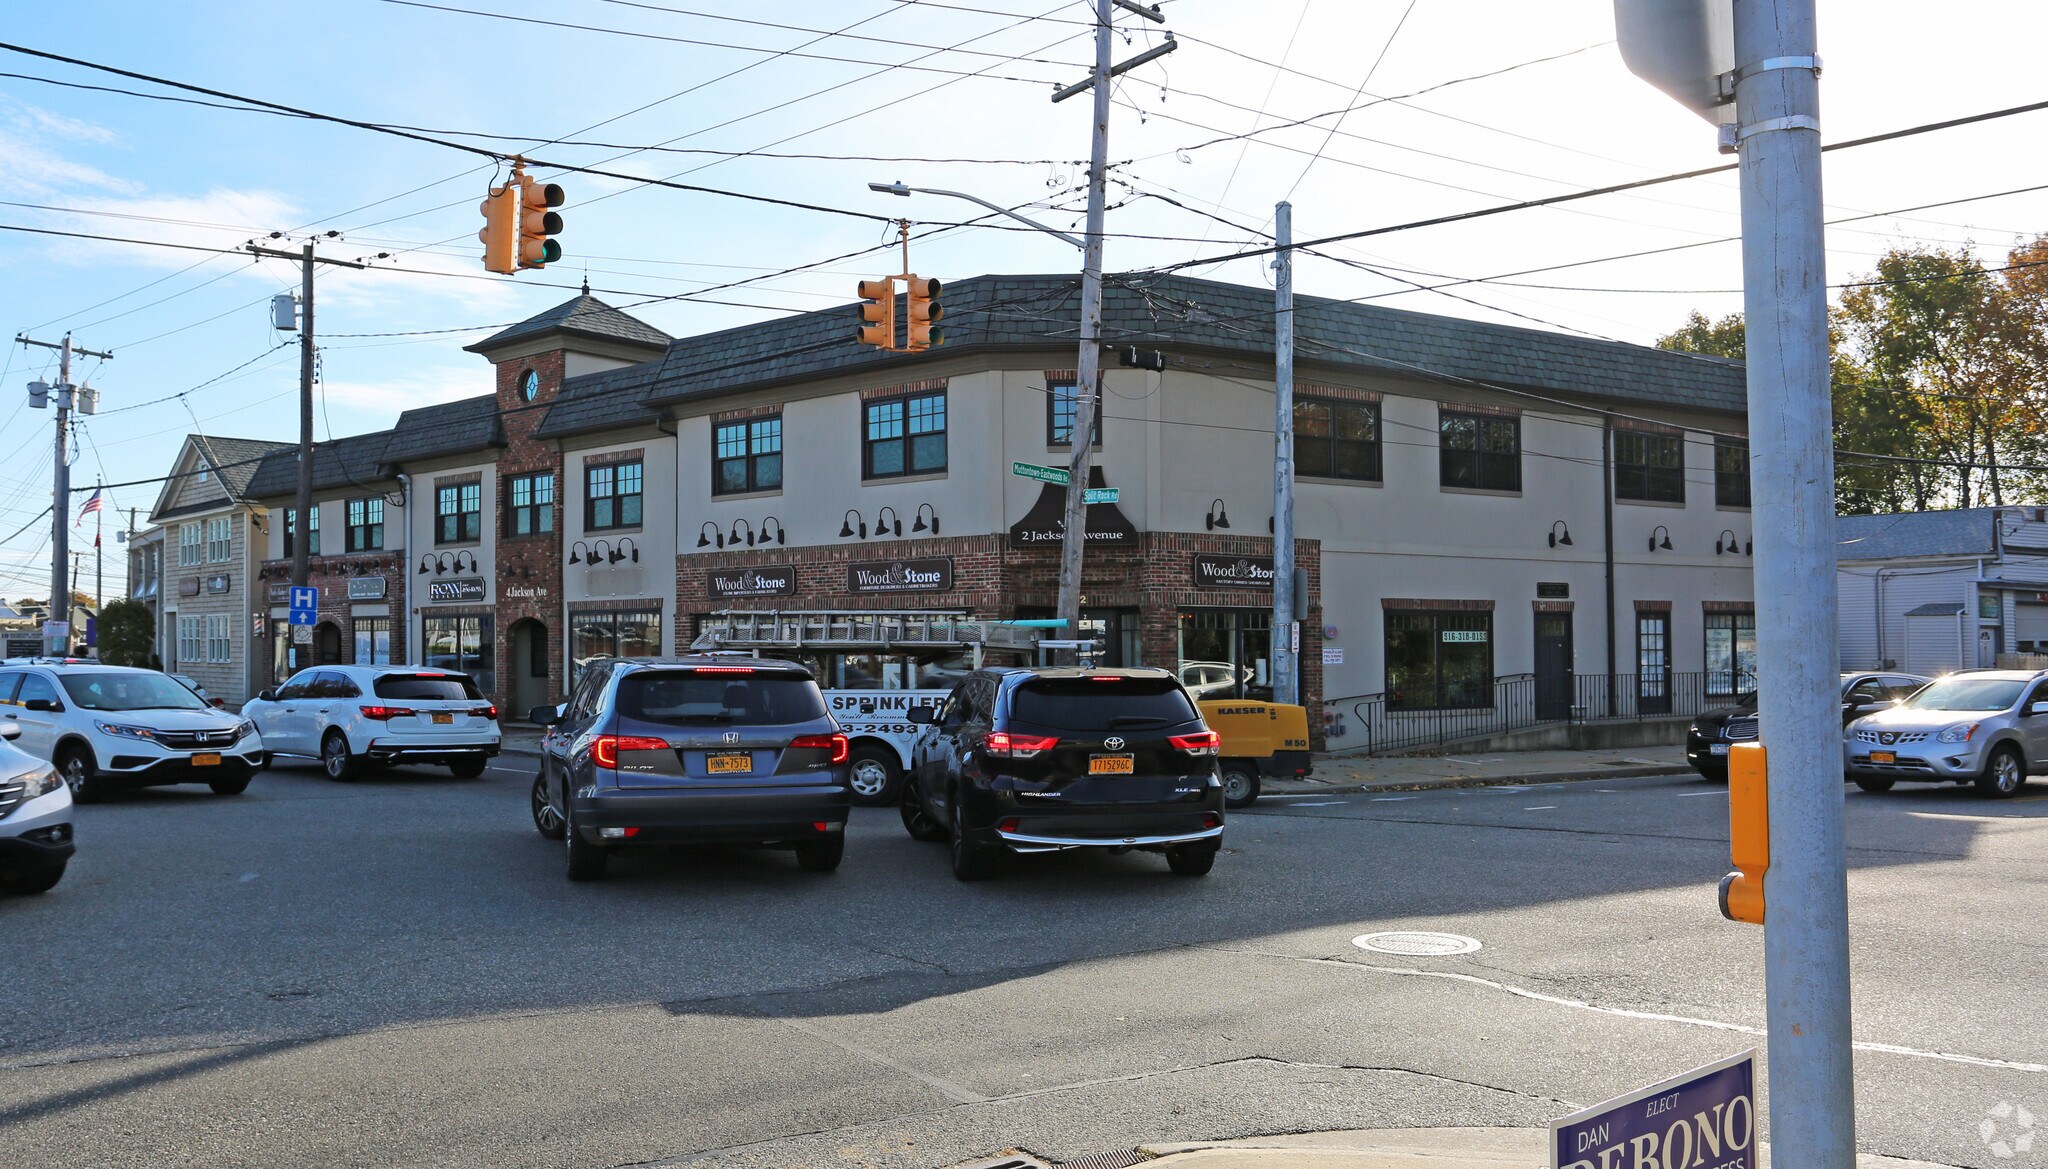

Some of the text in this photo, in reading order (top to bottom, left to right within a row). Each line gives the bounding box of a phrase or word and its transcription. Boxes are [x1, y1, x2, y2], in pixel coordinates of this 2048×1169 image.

[1084, 491, 1096, 501] Split
[1098, 491, 1110, 499] Rock
[1021, 531, 1029, 540] 2
[1031, 531, 1066, 542] Jackso
[511, 587, 535, 598] Jackson
[537, 587, 547, 596] Ave
[295, 589, 312, 608] H
[1080, 595, 1086, 604] 2
[1218, 707, 1265, 715] KAESER
[1094, 760, 1130, 771] T715296C
[1646, 1093, 1679, 1118] ELECT
[1578, 1122, 1609, 1153] DAN
